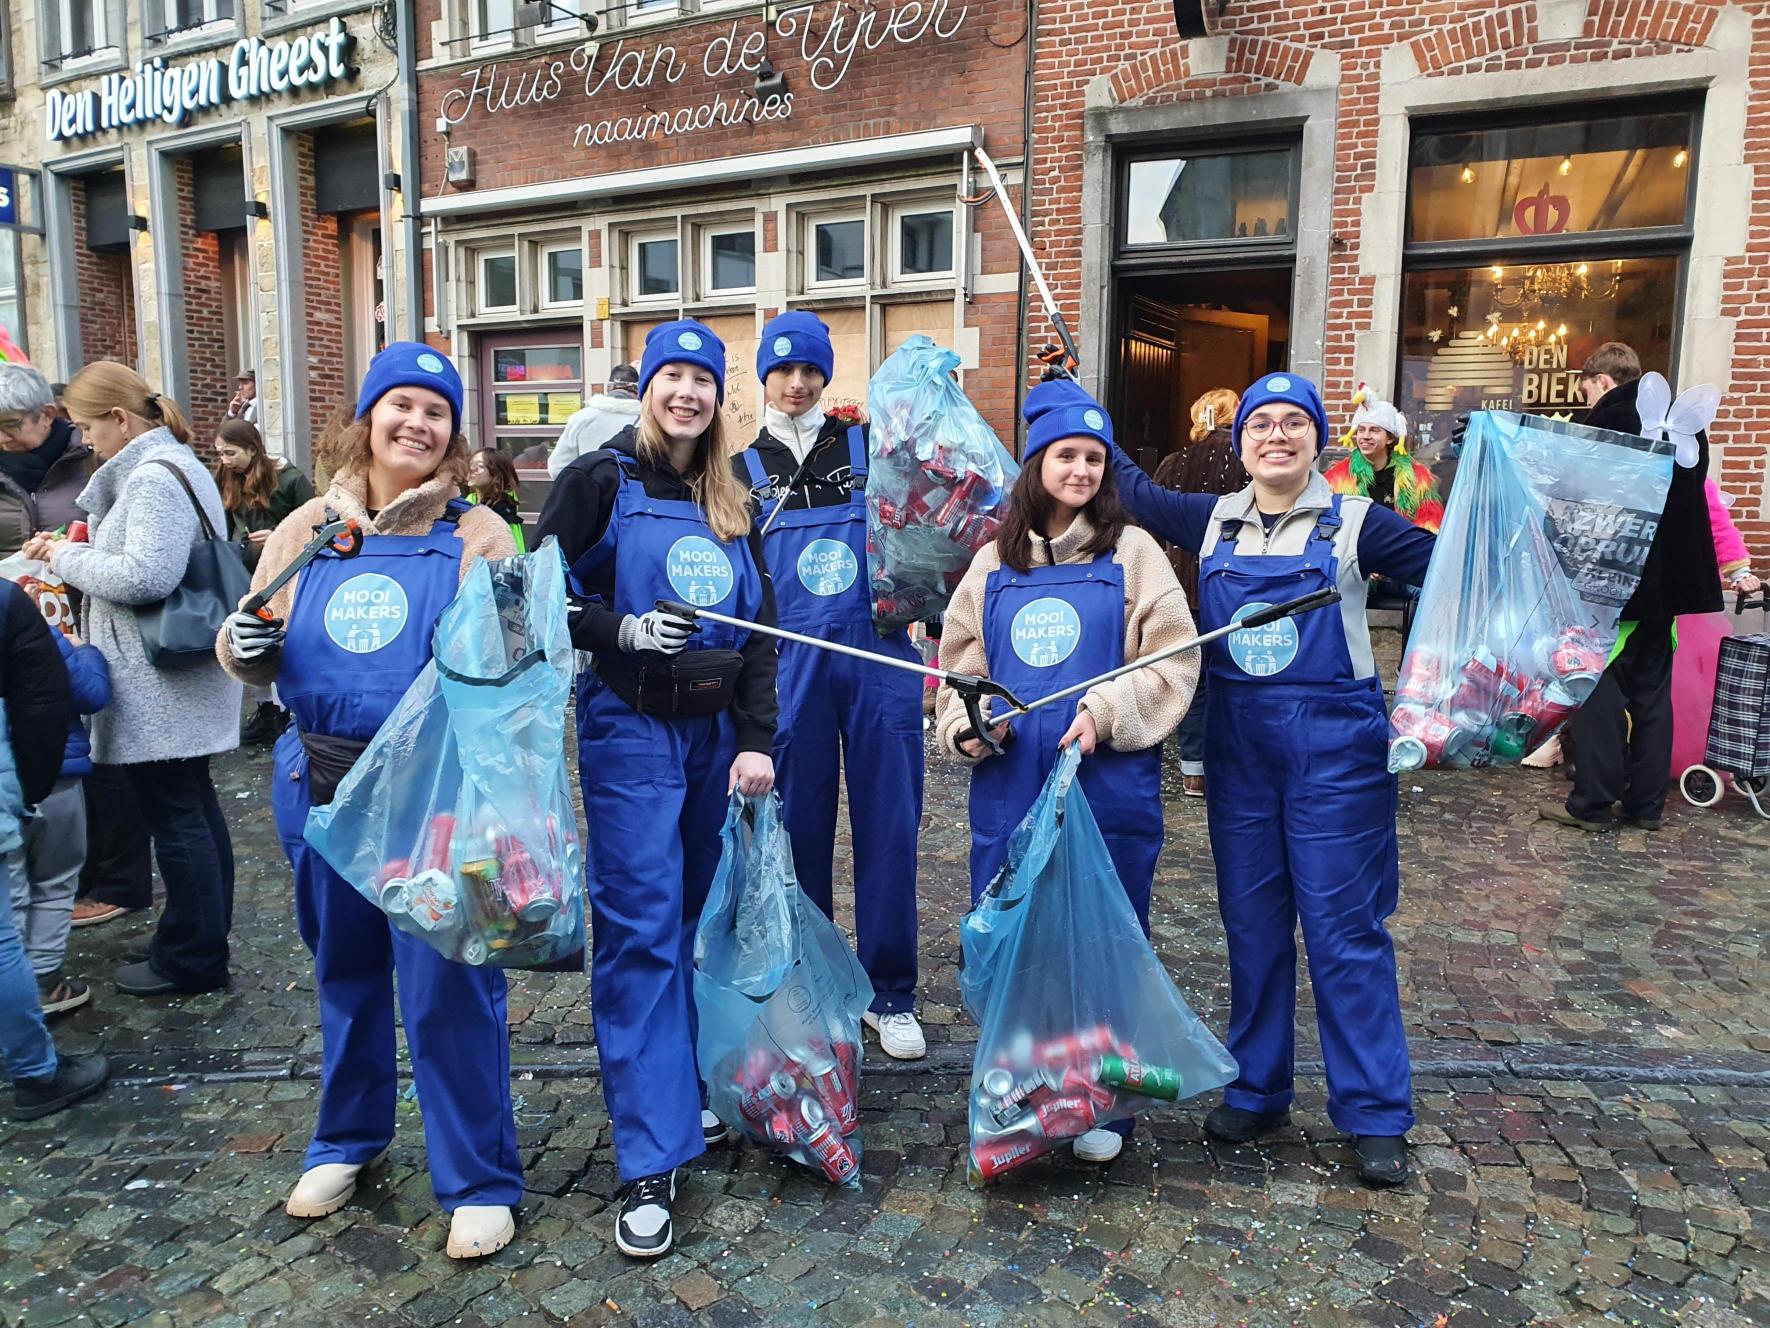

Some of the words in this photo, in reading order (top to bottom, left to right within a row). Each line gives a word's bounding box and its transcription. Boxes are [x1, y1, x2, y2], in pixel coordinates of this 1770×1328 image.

[46, 88, 98, 141] Den
[101, 57, 223, 129] Heiligen
[228, 17, 347, 99] Gheest
[441, 61, 564, 124] Huis
[570, 40, 687, 97] Van
[703, 20, 766, 77] de
[573, 91, 794, 148] naaimachines
[1524, 344, 1568, 370] DEN
[679, 550, 717, 563] MOOI
[808, 550, 842, 563] MOOI
[672, 565, 729, 578] MAKERS
[801, 559, 853, 577] MAKERS
[343, 589, 390, 604] MOOI
[331, 605, 401, 621] MAKERS
[1025, 611, 1064, 625] MOOI
[1015, 624, 1075, 640] MAKERS
[1232, 633, 1293, 647] MAKERS
[1040, 1098, 1081, 1119] Jupiler
[991, 1143, 1032, 1170] Jupiler
